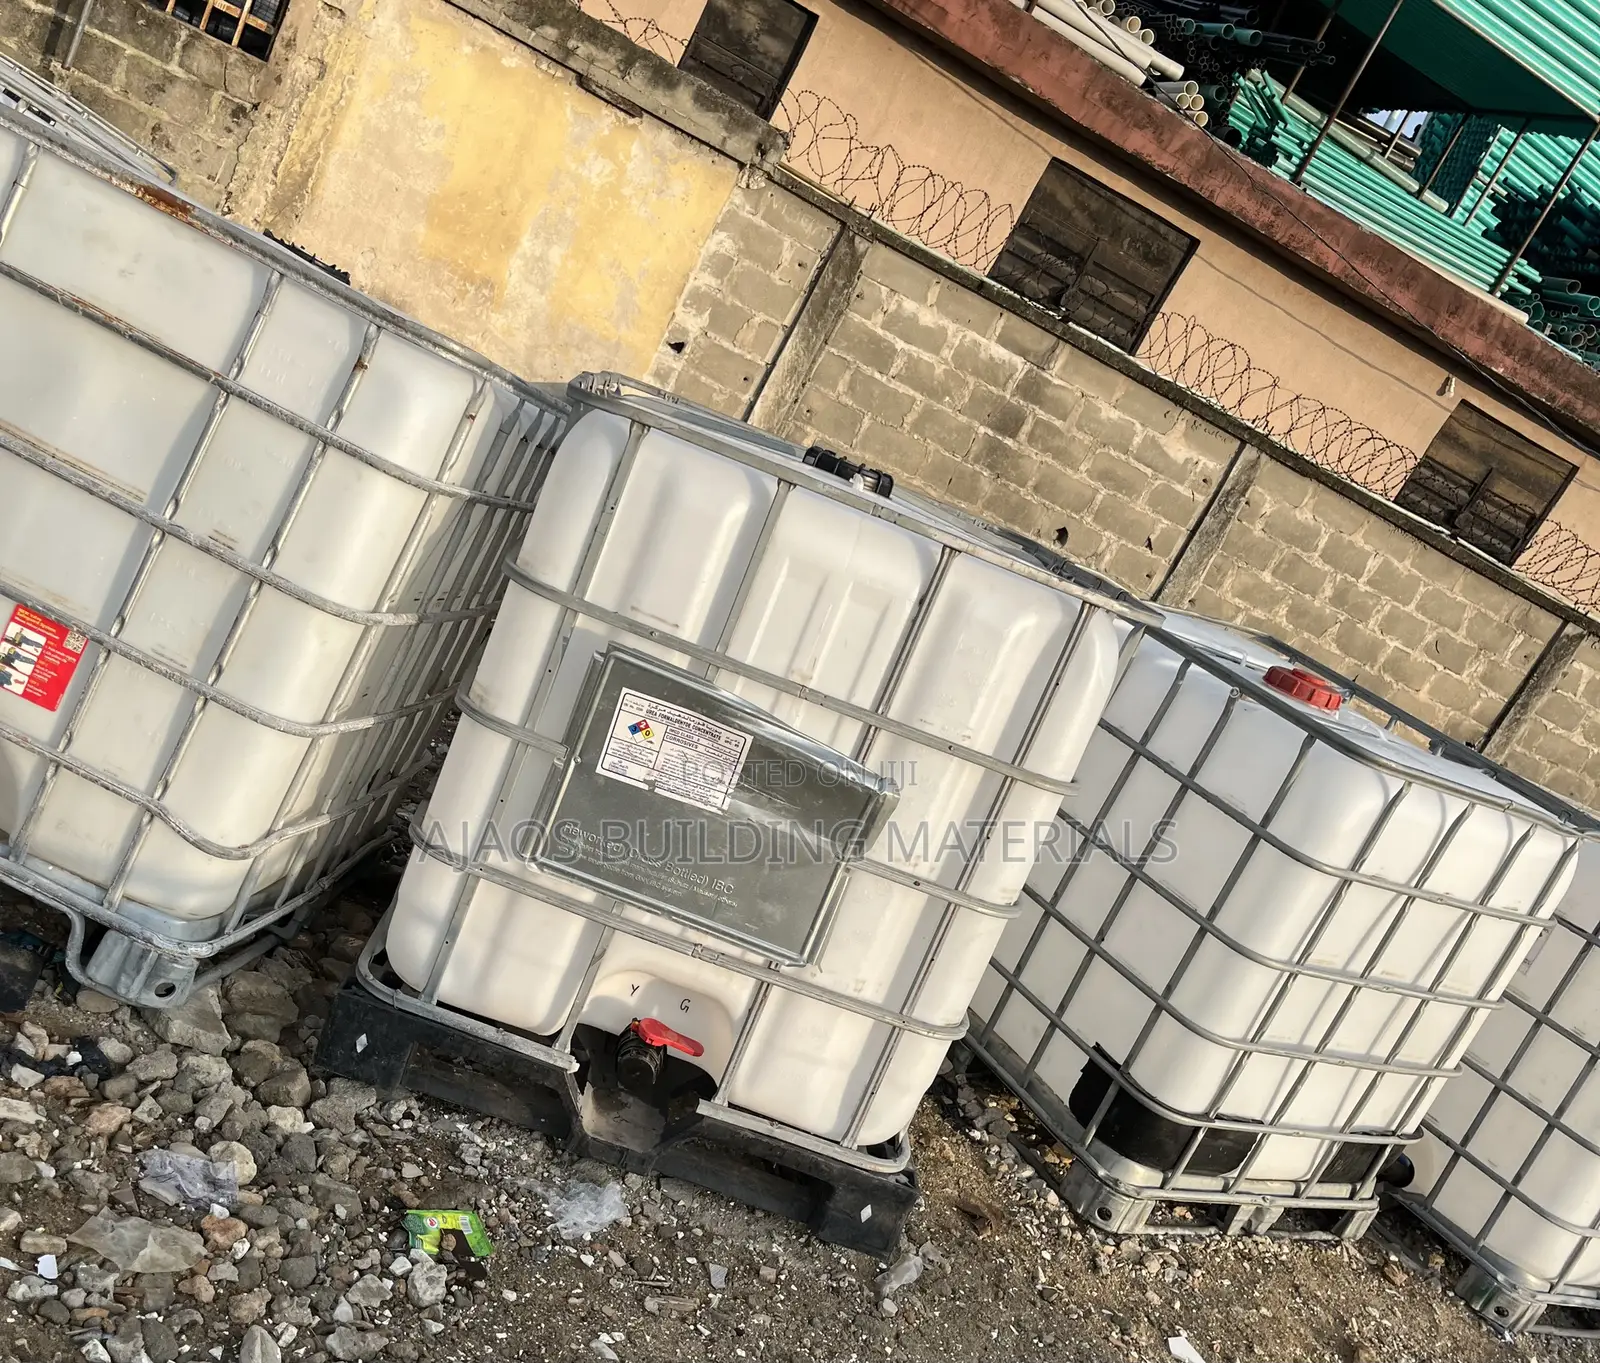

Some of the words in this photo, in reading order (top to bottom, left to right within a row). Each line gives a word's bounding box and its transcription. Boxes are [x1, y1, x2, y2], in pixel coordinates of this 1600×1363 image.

[645, 707, 657, 716] UREA
[690, 724, 721, 740] CONCENTRATE
[665, 734, 698, 749] CORROSIVES
[663, 860, 710, 888] Bottled)
[710, 877, 735, 896] IBC
[630, 984, 640, 996] Y
